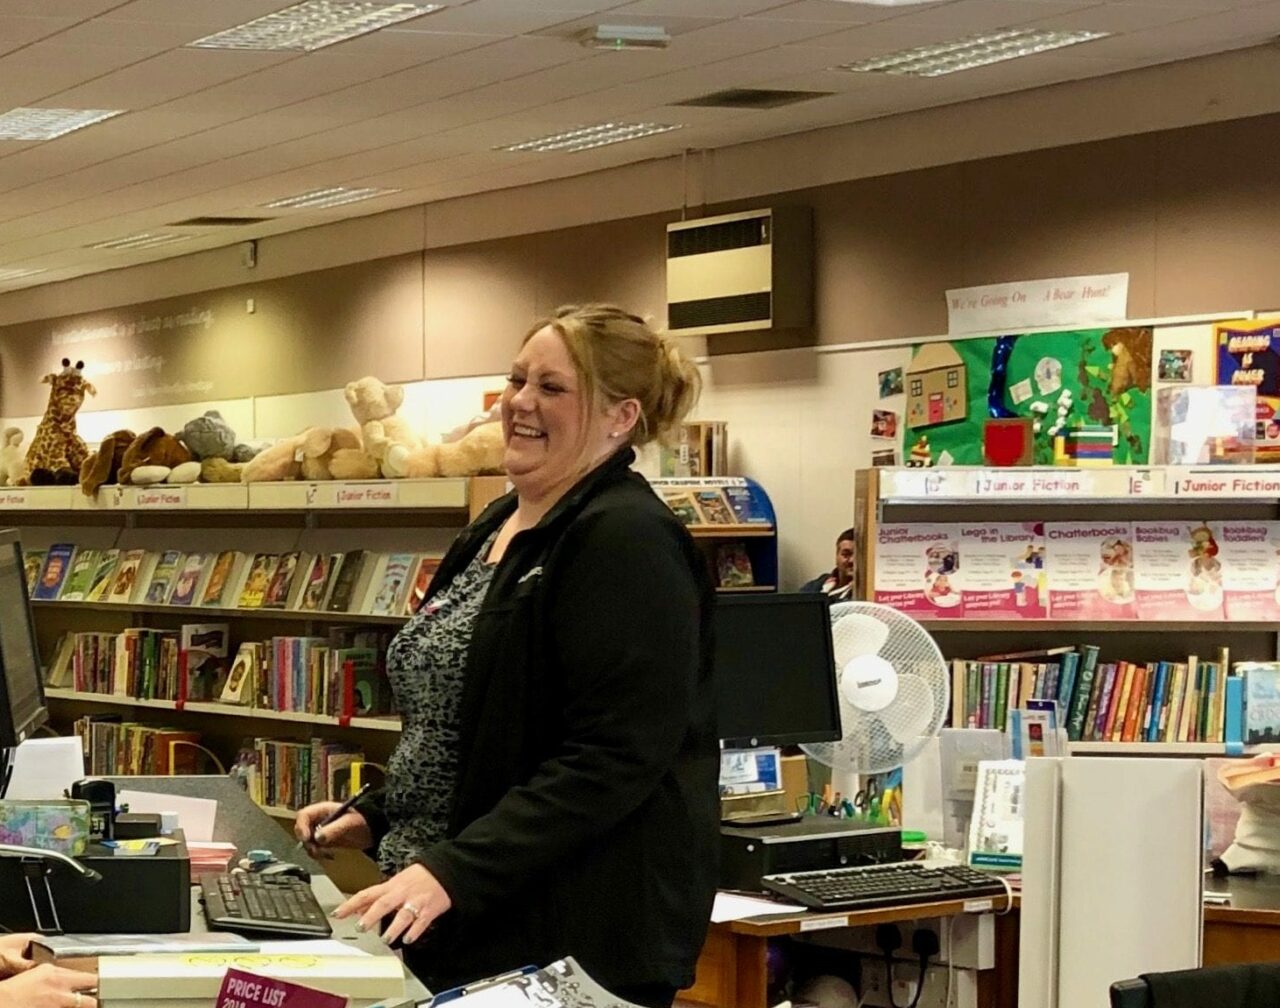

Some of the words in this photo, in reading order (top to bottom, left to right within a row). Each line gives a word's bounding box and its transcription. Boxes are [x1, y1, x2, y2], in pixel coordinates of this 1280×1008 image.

[983, 479, 1025, 491] Junior
[1033, 479, 1079, 491] Fiction
[1182, 479, 1227, 492] Junior
[1232, 479, 1280, 491] Fiction
[878, 527, 909, 536] Junior
[961, 528, 987, 538] Lego
[1048, 526, 1128, 540] Chatterbooks
[1135, 526, 1180, 536] Bookbug
[1223, 526, 1268, 536] Bookbug
[879, 533, 949, 545] Chatterbooks
[981, 535, 998, 543] the
[1000, 534, 1035, 543] Library
[1136, 534, 1169, 543] Babies
[226, 978, 262, 1001] PRICE
[262, 986, 287, 1007] LIST
